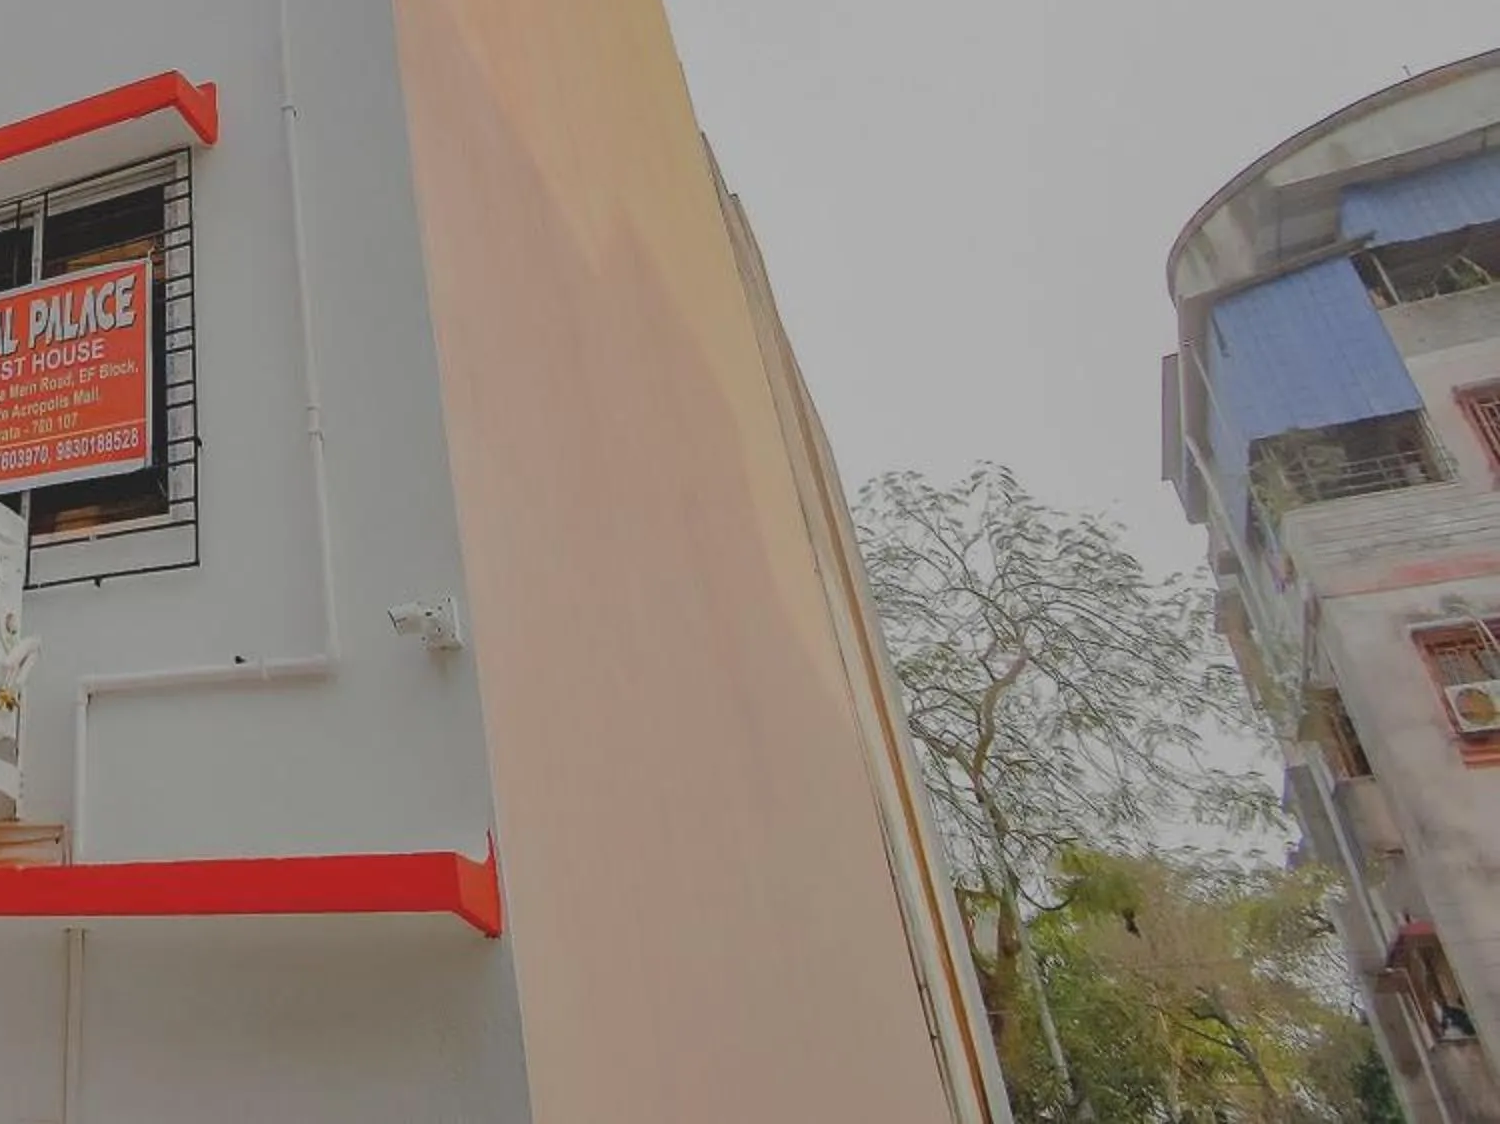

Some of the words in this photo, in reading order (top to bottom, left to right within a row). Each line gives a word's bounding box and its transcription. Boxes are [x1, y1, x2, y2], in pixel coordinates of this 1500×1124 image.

[28, 273, 137, 350] PALACE
[31, 338, 105, 375] HOUSE
[79, 366, 97, 383] EF
[11, 395, 70, 418] Acropolis
